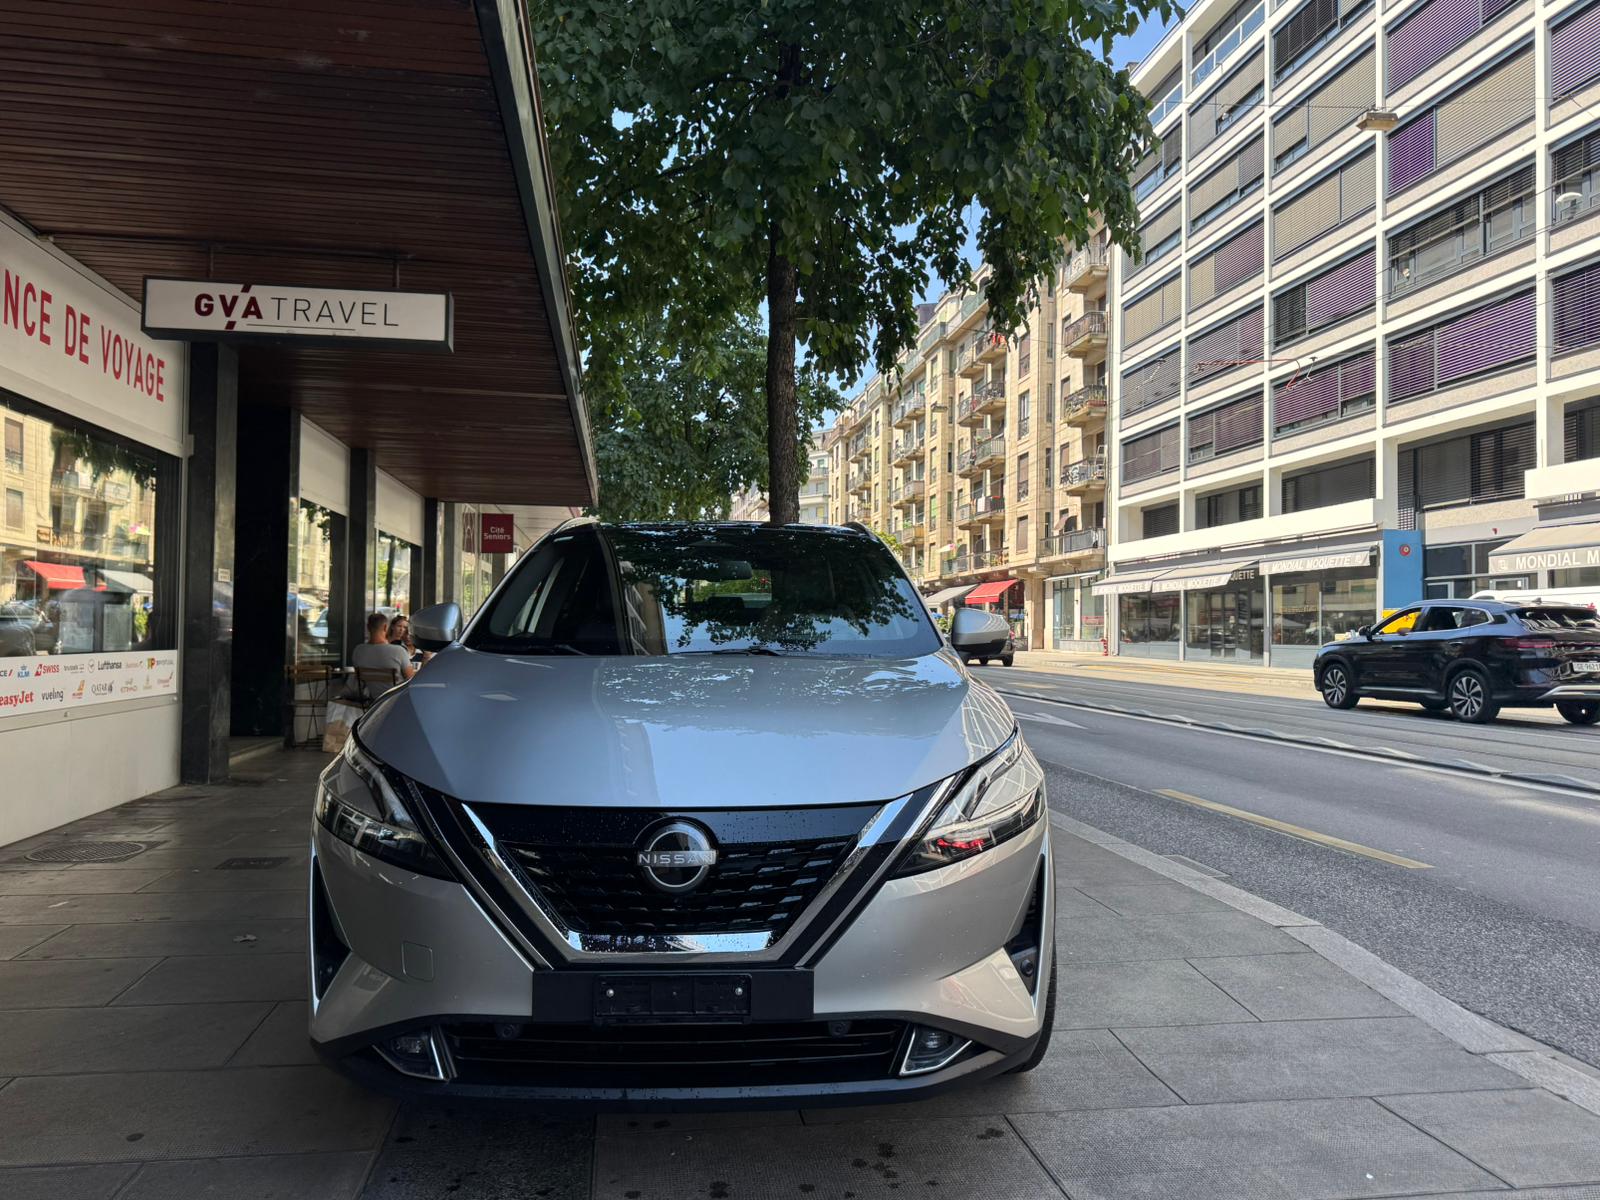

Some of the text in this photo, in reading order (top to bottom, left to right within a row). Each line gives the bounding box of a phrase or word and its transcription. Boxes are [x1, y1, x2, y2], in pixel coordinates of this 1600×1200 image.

[194, 293, 399, 326] GVA TRAVEL
[4, 269, 165, 402] NCE DE VOYAGE
[1307, 556, 1350, 569] MOQUETTE
[1516, 552, 1580, 570] MONDIAL
[43, 664, 59, 674] SWISS
[0, 690, 34, 707] easyJet
[42, 688, 64, 702] vueling
[639, 853, 712, 864] NISSAN
